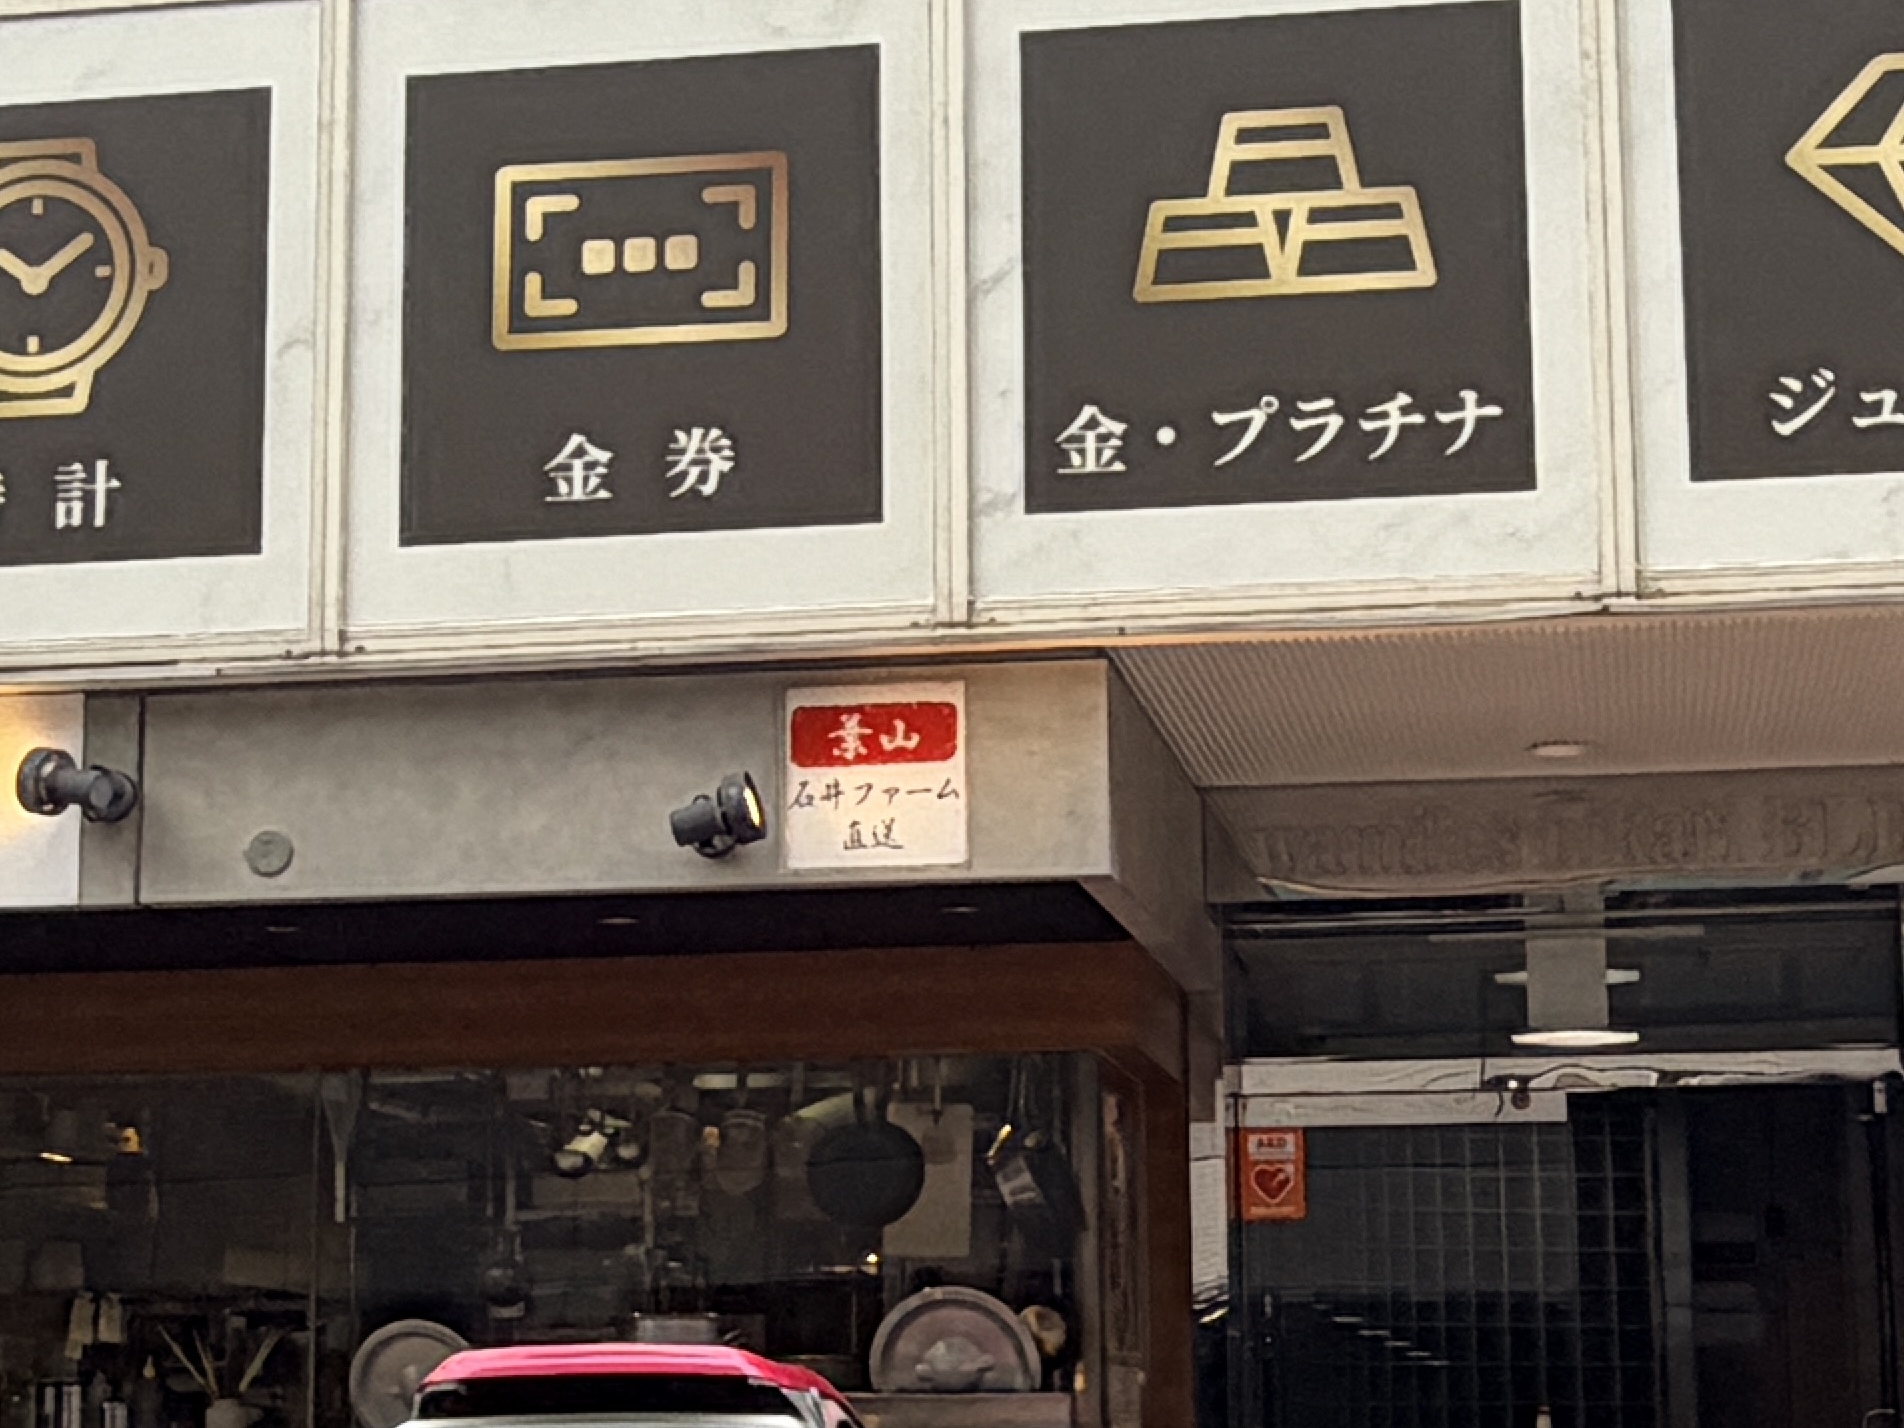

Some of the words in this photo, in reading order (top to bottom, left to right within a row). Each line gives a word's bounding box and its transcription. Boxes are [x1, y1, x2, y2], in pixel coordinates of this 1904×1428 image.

[1055, 390, 1504, 476] 金・プラチナ
[544, 427, 736, 502] 金券
[828, 713, 921, 761] 葉山
[788, 779, 961, 811] 石井ファーム
[842, 818, 904, 850] 直送
